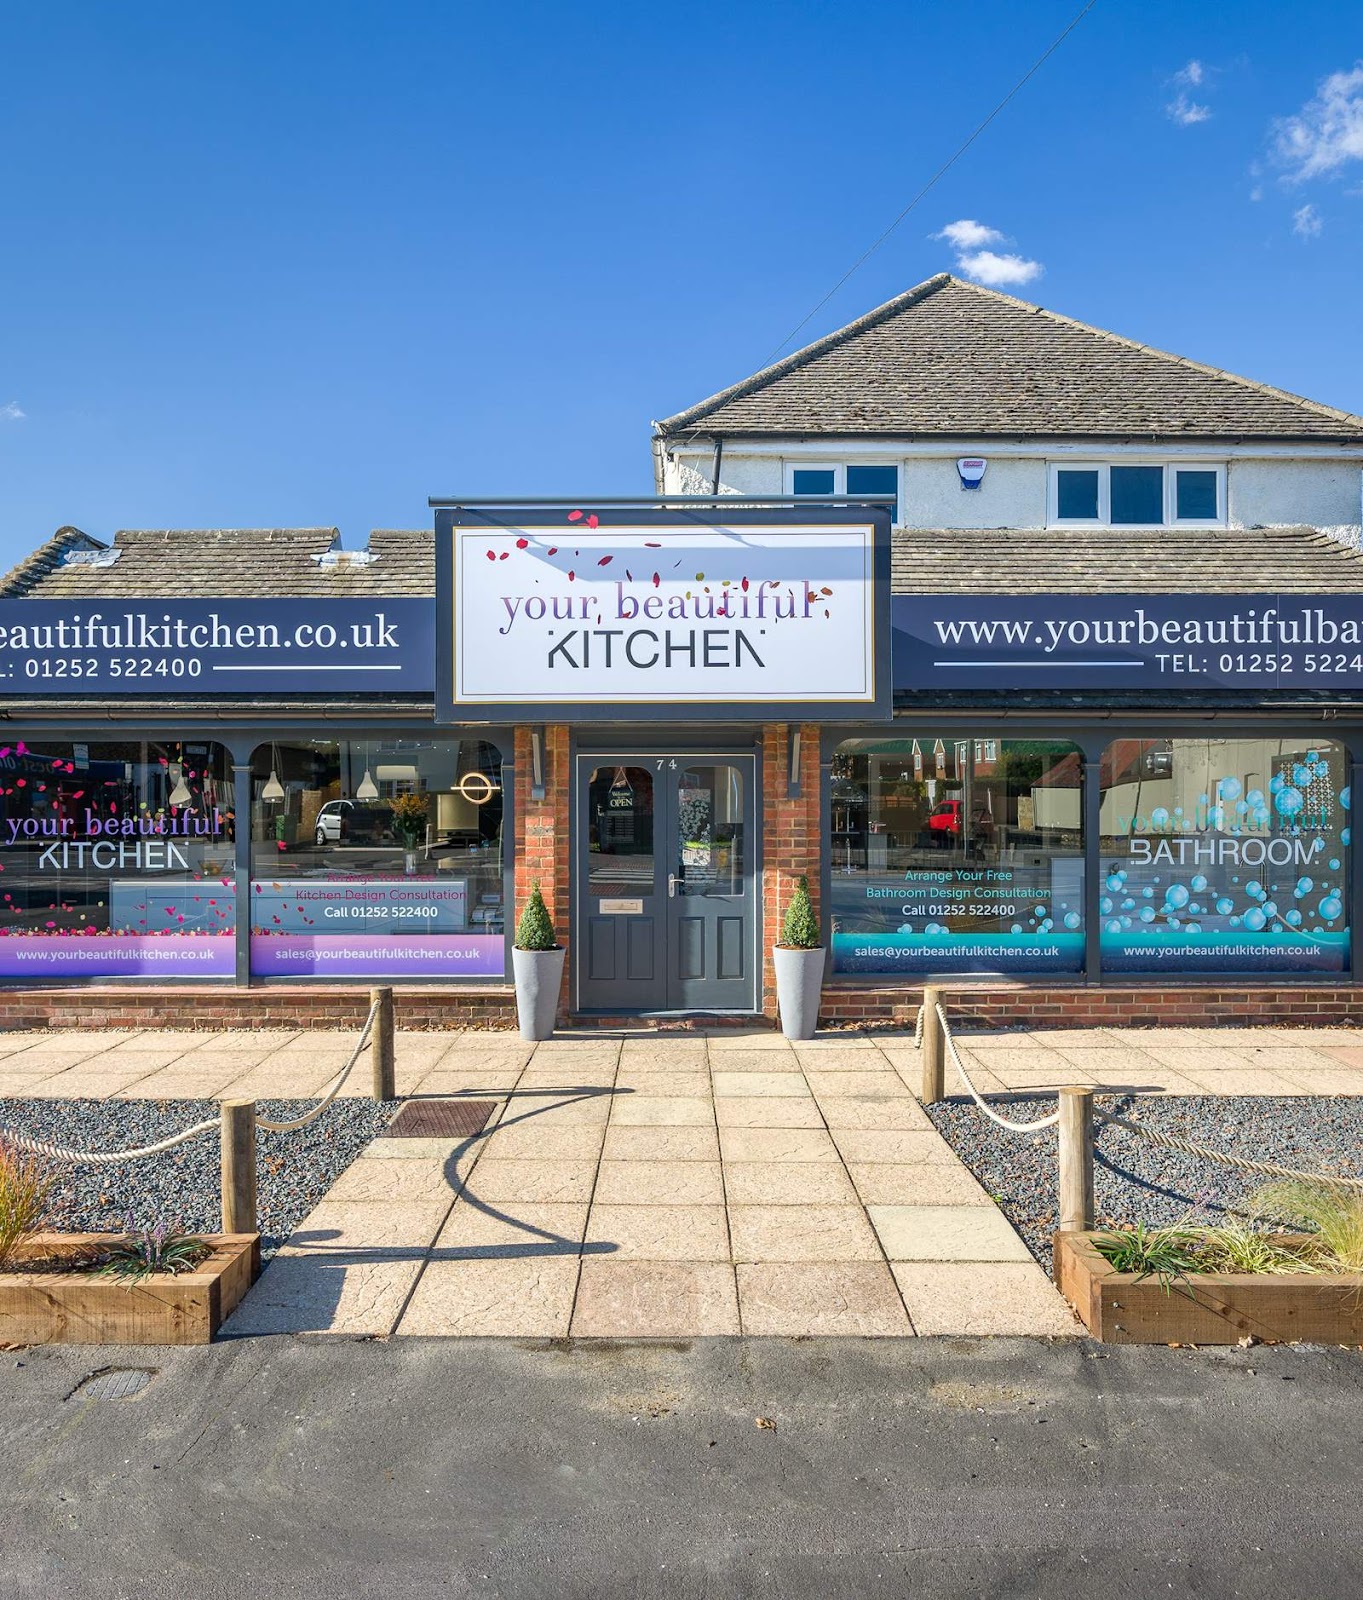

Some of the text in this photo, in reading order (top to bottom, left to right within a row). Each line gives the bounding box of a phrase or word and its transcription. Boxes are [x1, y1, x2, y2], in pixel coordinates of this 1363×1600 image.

[499, 580, 814, 635] your beautiful
[934, 610, 1363, 652] www.yourbeautifulba
[548, 629, 766, 669] KITCHEN
[25, 658, 98, 678] 01252
[110, 658, 202, 678] 522400
[1155, 654, 1208, 673] TEL:
[1219, 654, 1294, 673] 01252
[610, 798, 633, 807] OPEN
[6, 807, 223, 845] your beautiful
[39, 840, 190, 870] KITCHEN
[904, 870, 1013, 884] Arrange Your Free
[296, 889, 467, 903] Kitchen Design Consultation
[866, 887, 1051, 901] Bathroom Design Consultation
[324, 906, 438, 918] Call 01252 522400
[902, 904, 1015, 917] Call 01252 522400
[16, 948, 215, 961] www.yourbeautifulkitchen.co.uk
[275, 948, 481, 961] sales@yourbeautifulkitchen.co.uk
[855, 946, 1059, 959] sales@yourbeautifulkitchen.co.uk
[1124, 944, 1321, 958] www.yourbeautifulkitchen.co.uk
